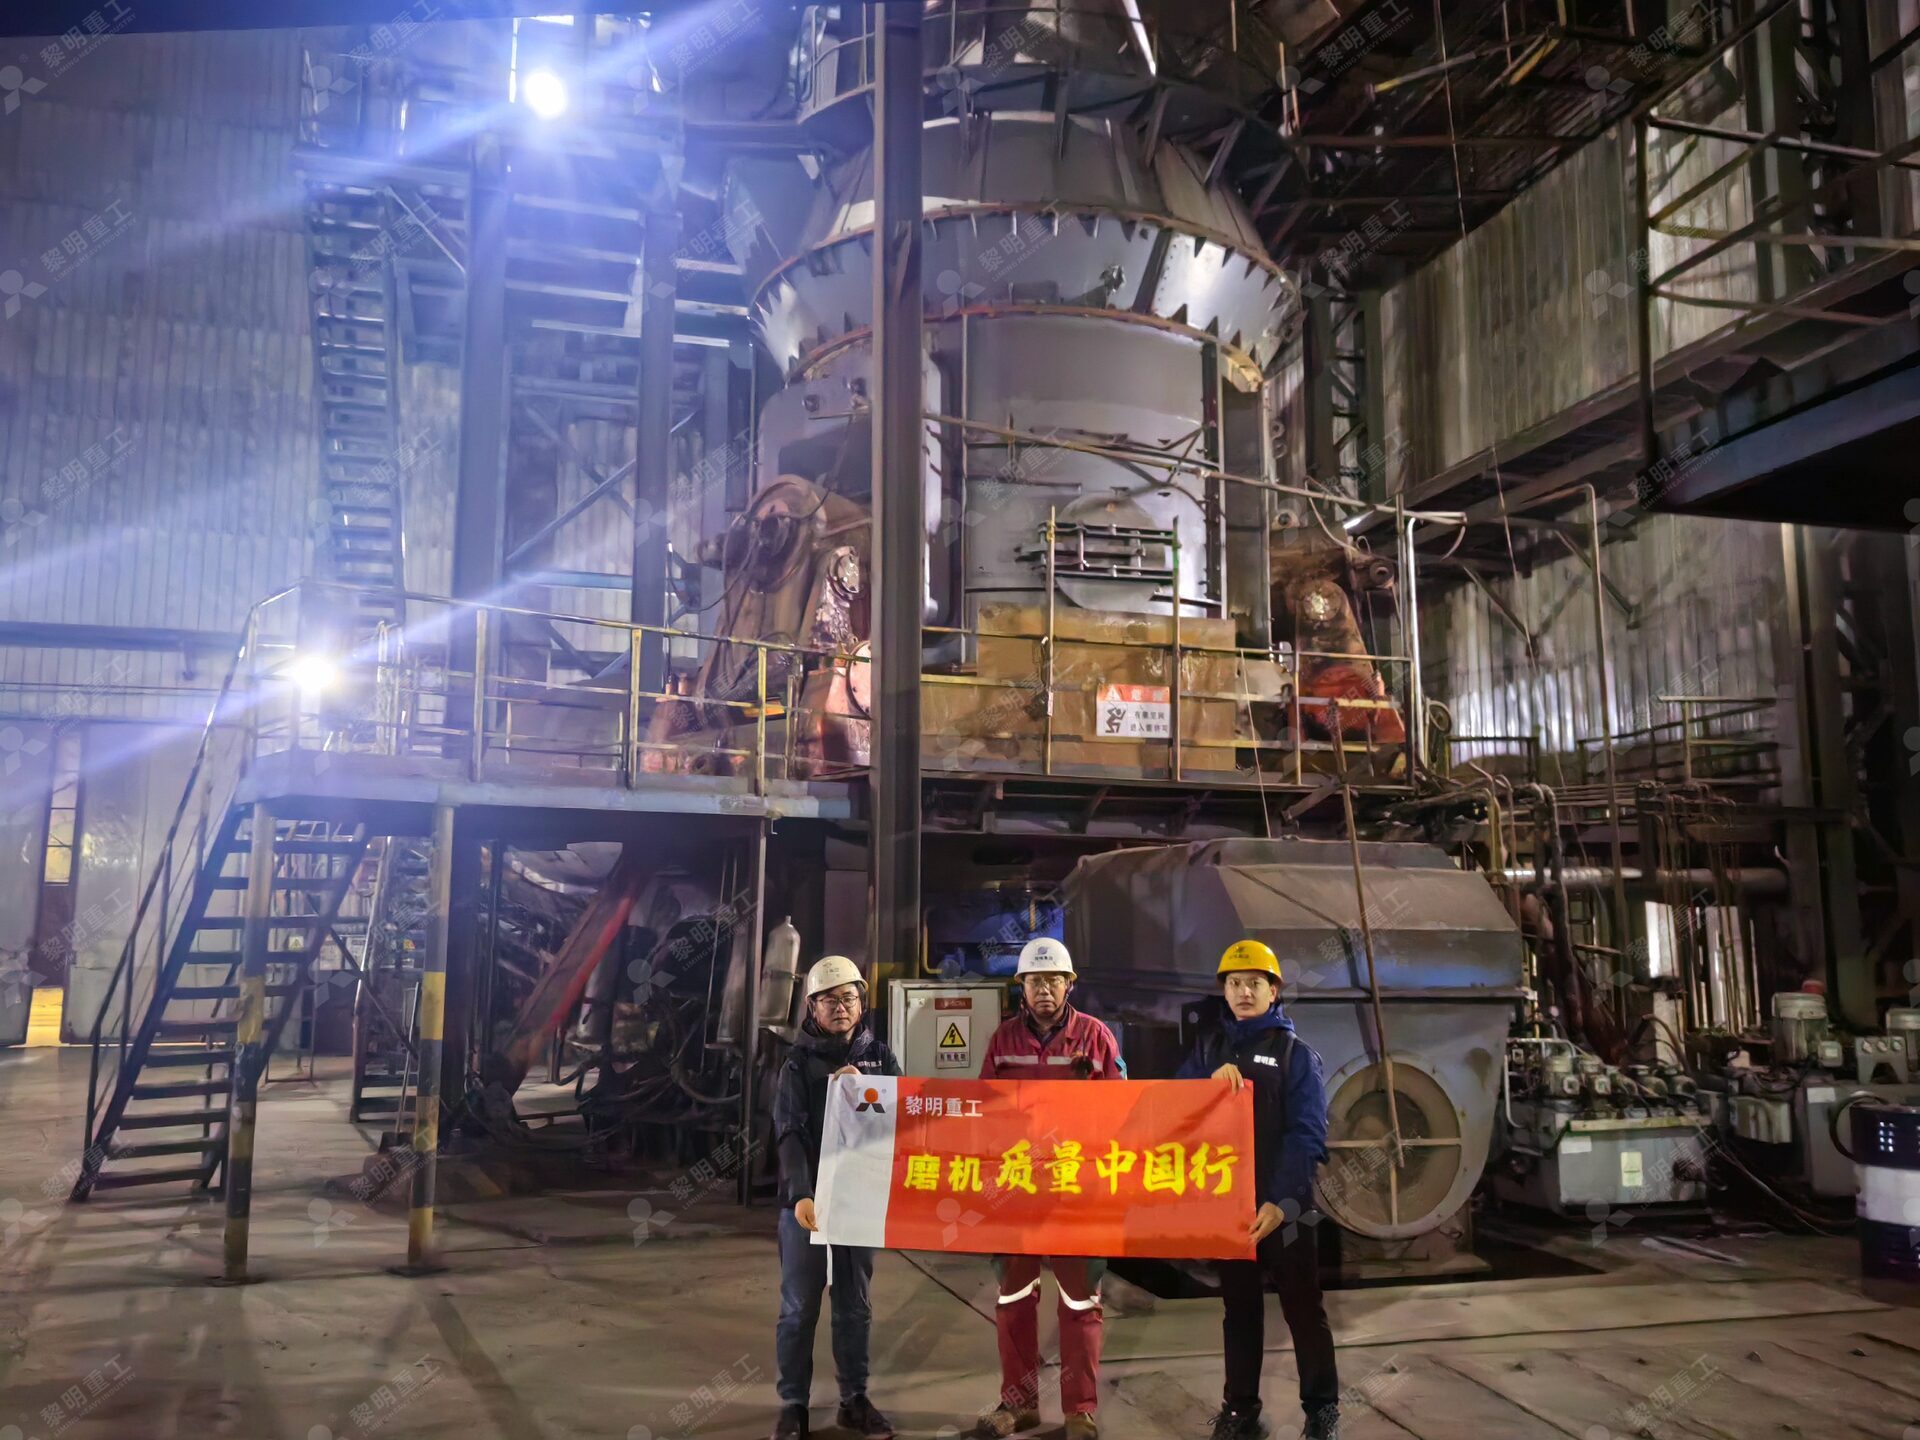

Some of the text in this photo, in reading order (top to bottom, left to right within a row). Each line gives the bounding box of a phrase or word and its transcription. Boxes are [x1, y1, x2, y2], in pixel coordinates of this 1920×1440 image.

[905, 1095, 983, 1118] 黎明重工
[903, 1139, 1240, 1196] 磨机质量中国行
